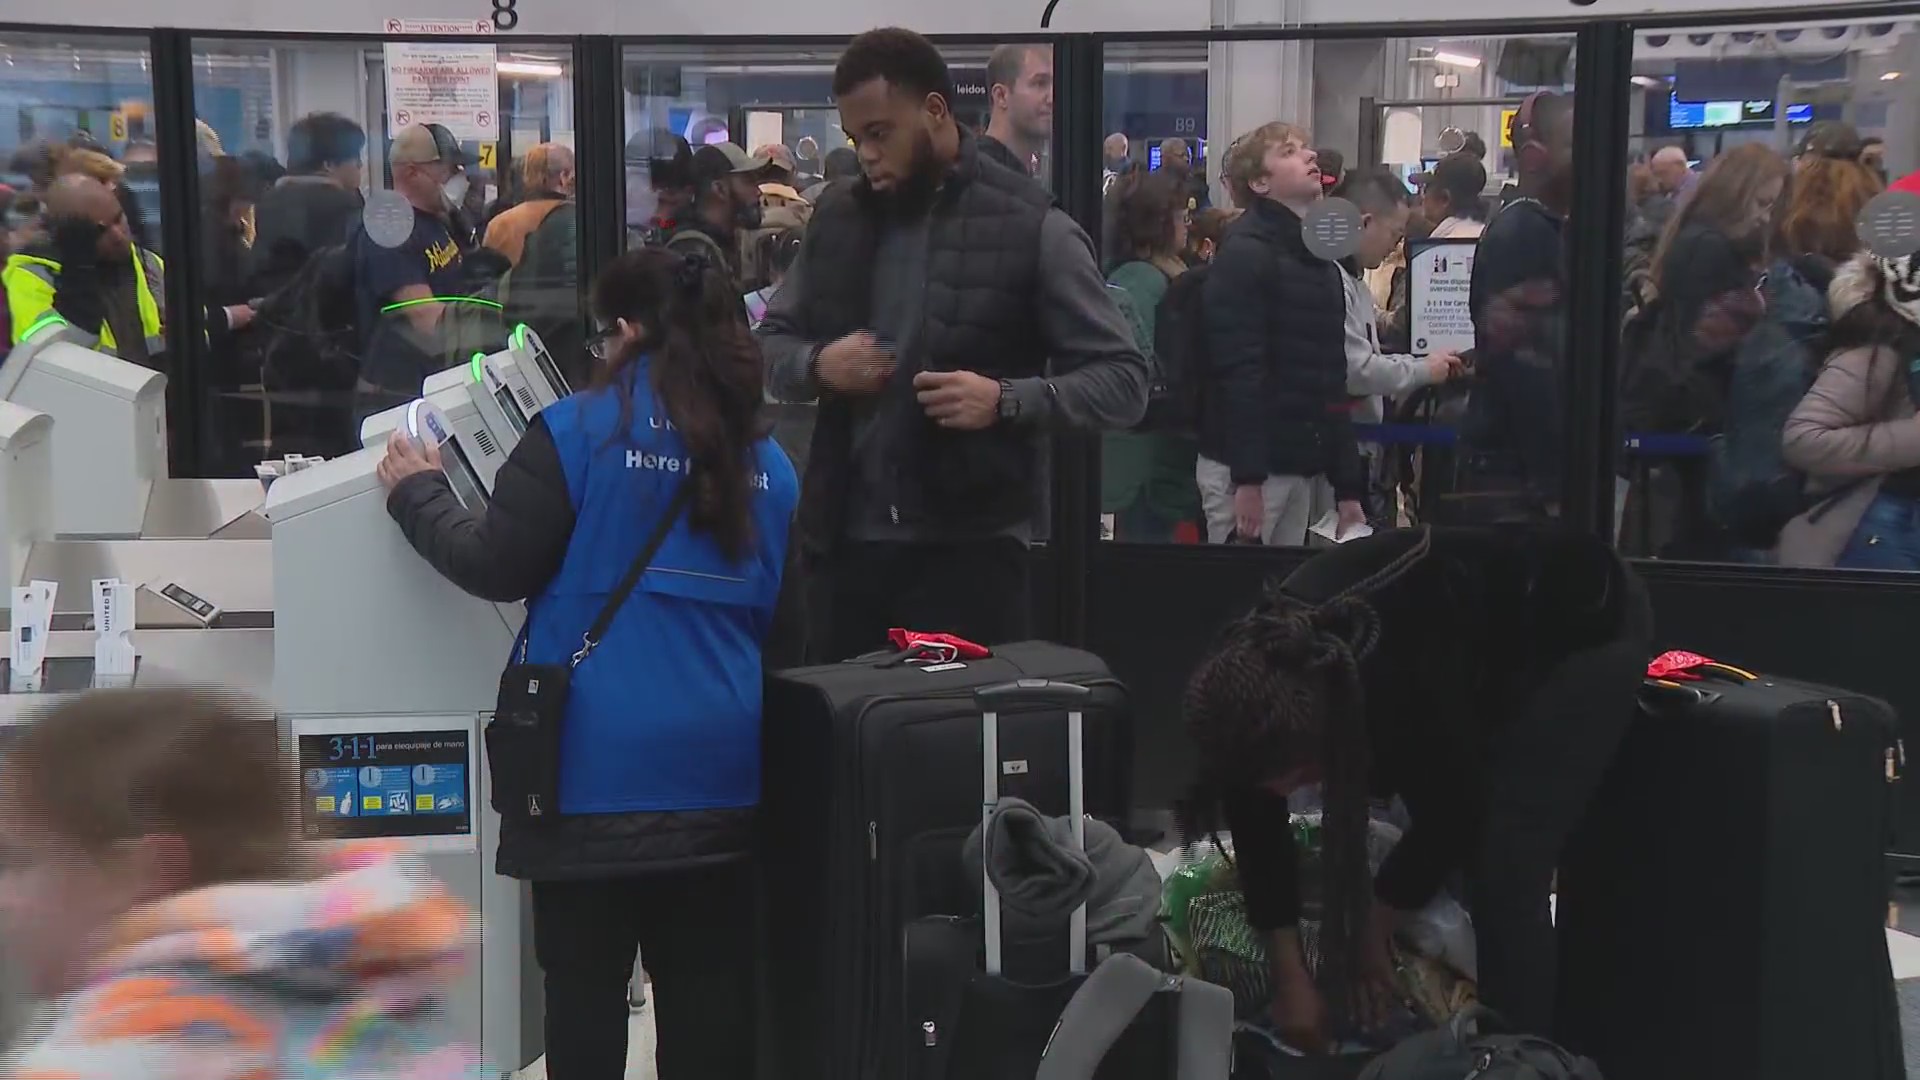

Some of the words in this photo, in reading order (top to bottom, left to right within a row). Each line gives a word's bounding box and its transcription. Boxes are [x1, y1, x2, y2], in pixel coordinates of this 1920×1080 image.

[492, 0, 518, 30] 8
[956, 84, 986, 95] leidos
[1175, 117, 1196, 132] B9
[482, 144, 493, 166] 7
[625, 450, 680, 472] Here
[329, 735, 377, 760] 3-1-1
[375, 743, 393, 751] para
[432, 740, 443, 748] de
